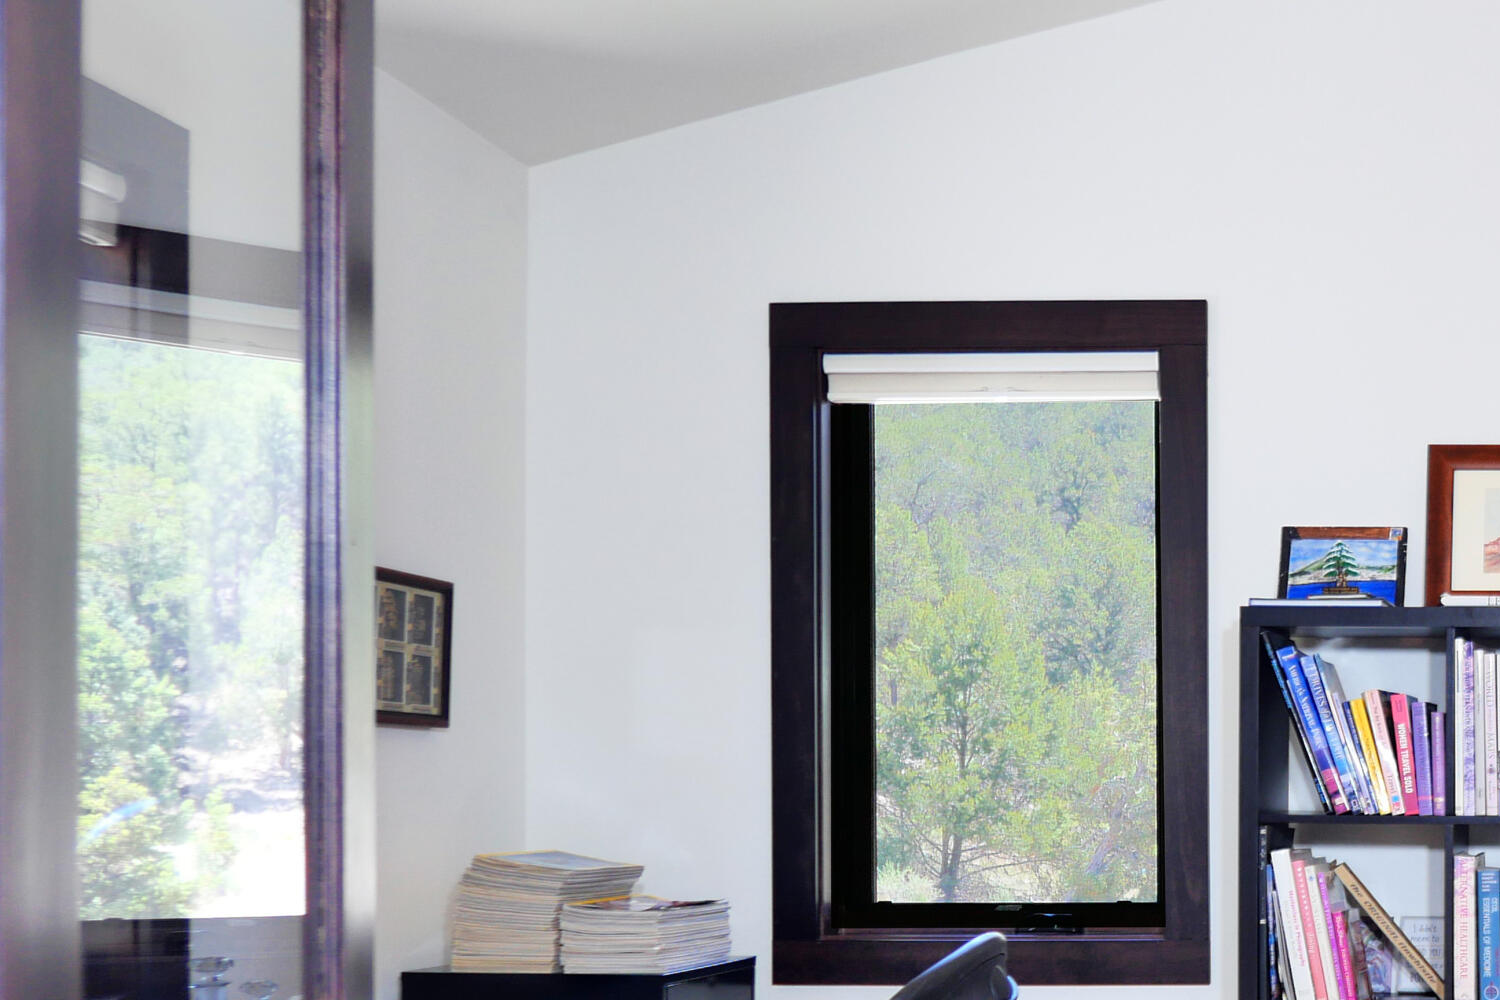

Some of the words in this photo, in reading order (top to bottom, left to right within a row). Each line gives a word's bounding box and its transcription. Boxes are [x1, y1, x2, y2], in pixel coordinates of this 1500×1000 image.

[1397, 723, 1407, 749] WOMEN
[1401, 751, 1411, 775] TRAVEL
[1404, 776, 1413, 793] SOLO
[1459, 860, 1468, 918] ALTERNATIVE
[1364, 901, 1399, 939] ORIGINAL
[1483, 897, 1491, 935] ESSENTIALS
[1459, 922, 1469, 979] HEALTHCARE
[1483, 936, 1490, 944] OF
[1483, 946, 1491, 978] MEDICINE
